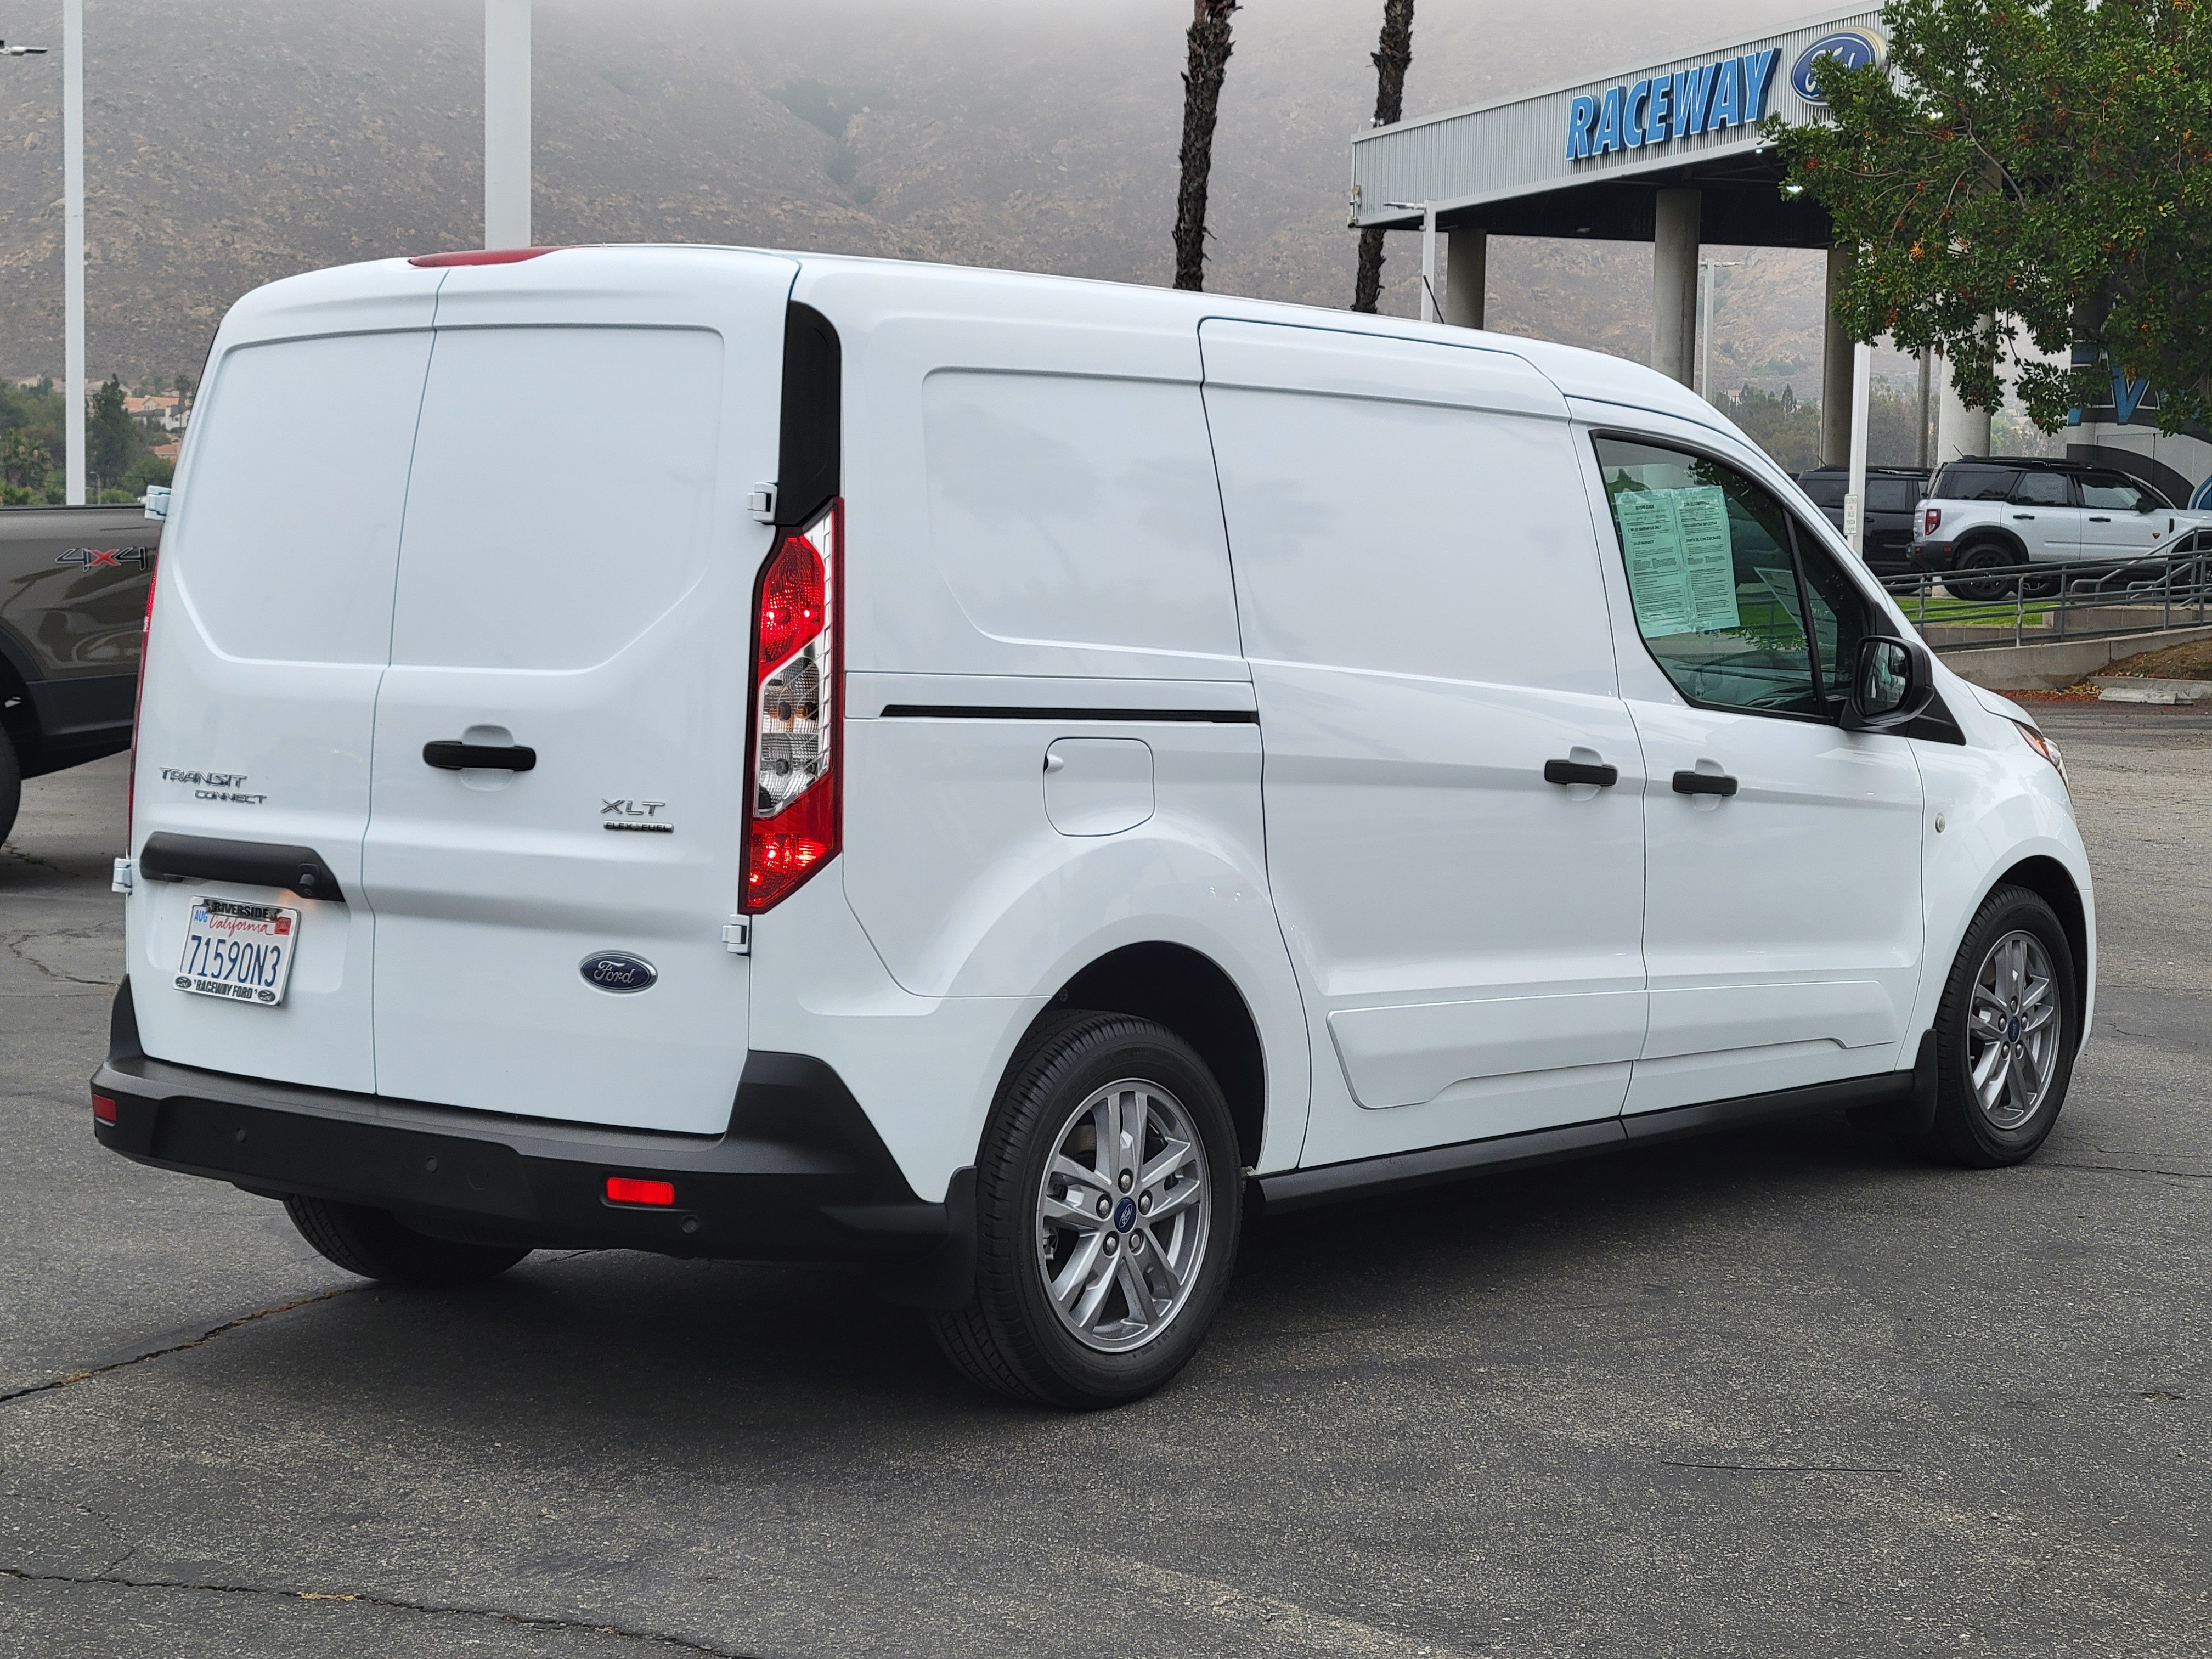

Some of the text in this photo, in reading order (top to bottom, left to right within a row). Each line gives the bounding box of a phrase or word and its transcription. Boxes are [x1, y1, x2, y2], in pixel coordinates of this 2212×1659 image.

[1565, 48, 1781, 161] RACEWAY
[159, 767, 247, 788] TRANSIT
[194, 789, 267, 805] CONNECT
[600, 798, 666, 816] XLT
[194, 910, 208, 923] AUG
[213, 901, 269, 919] RIVERSIDE
[209, 914, 274, 938] California
[188, 934, 281, 988] 71590N3
[594, 960, 636, 984] Ford
